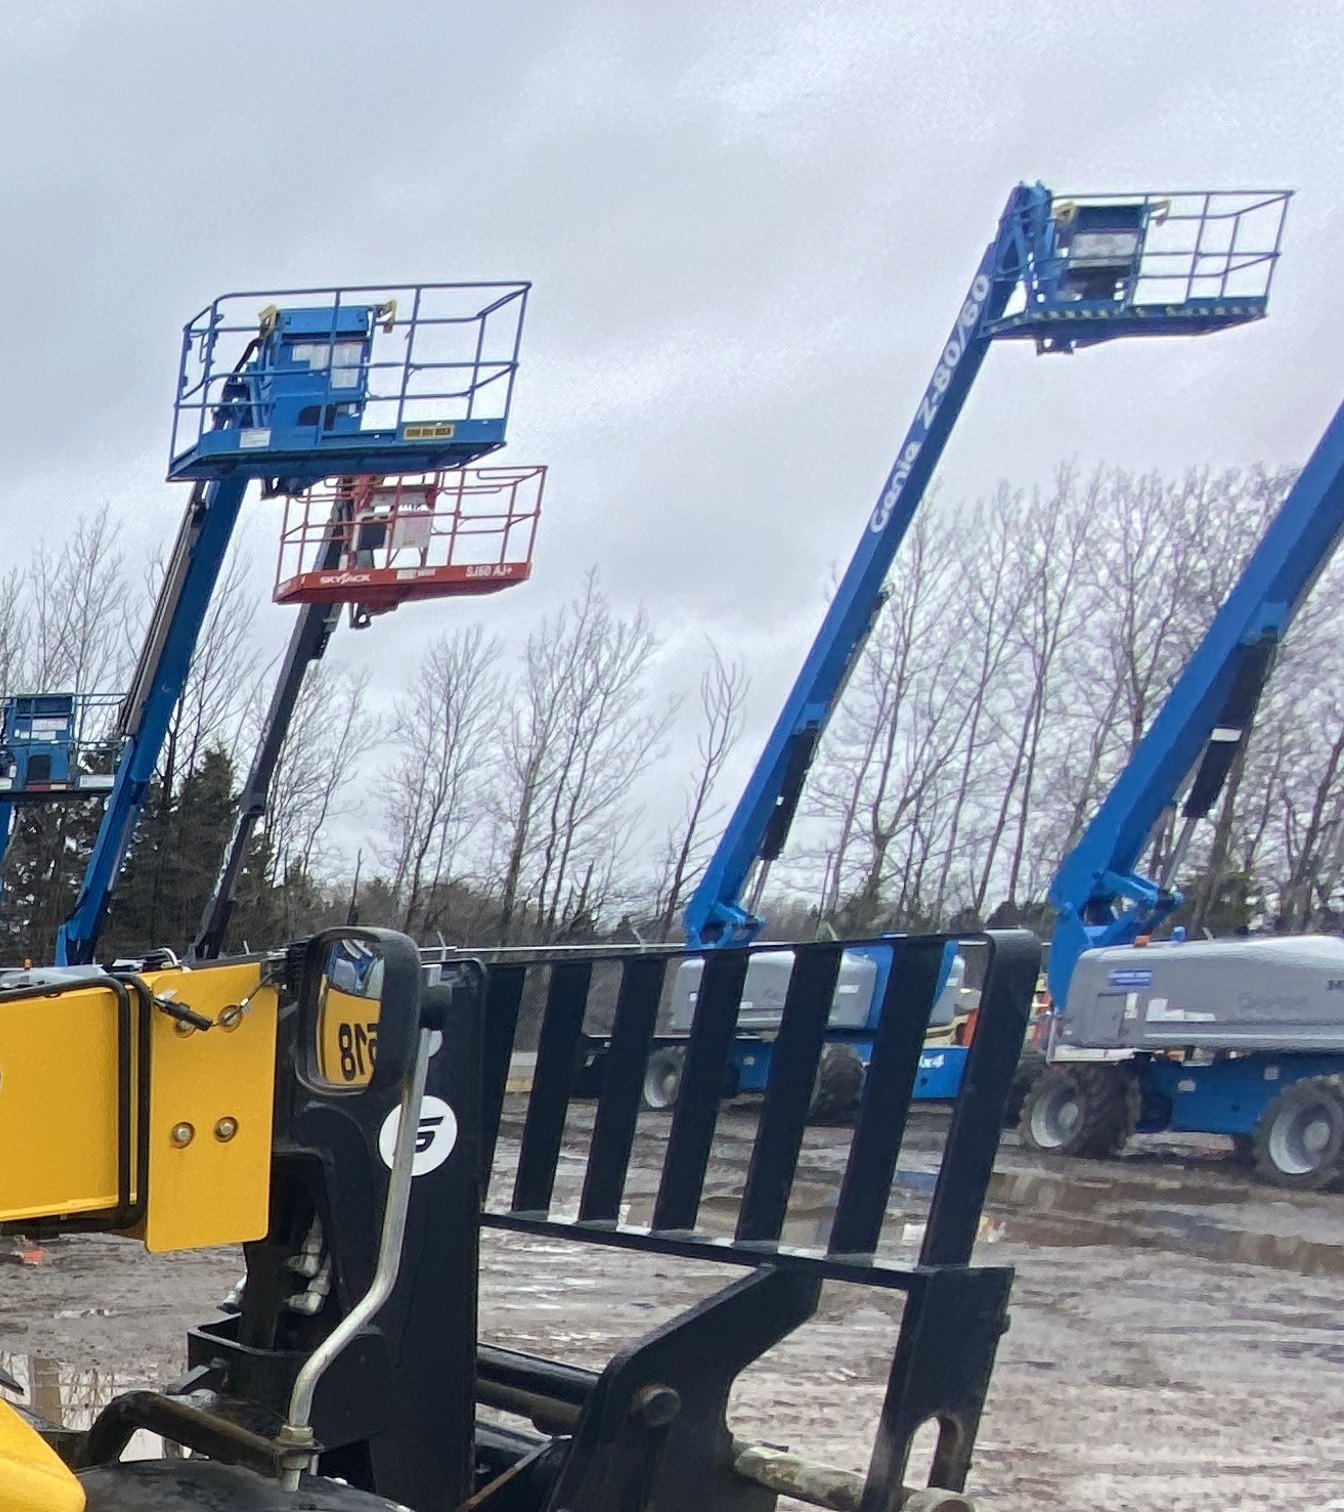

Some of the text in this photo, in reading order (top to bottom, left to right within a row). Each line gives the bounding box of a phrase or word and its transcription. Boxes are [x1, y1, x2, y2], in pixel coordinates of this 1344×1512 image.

[869, 273, 991, 534] Genie Z-80/60
[319, 571, 372, 585] SKYJACK
